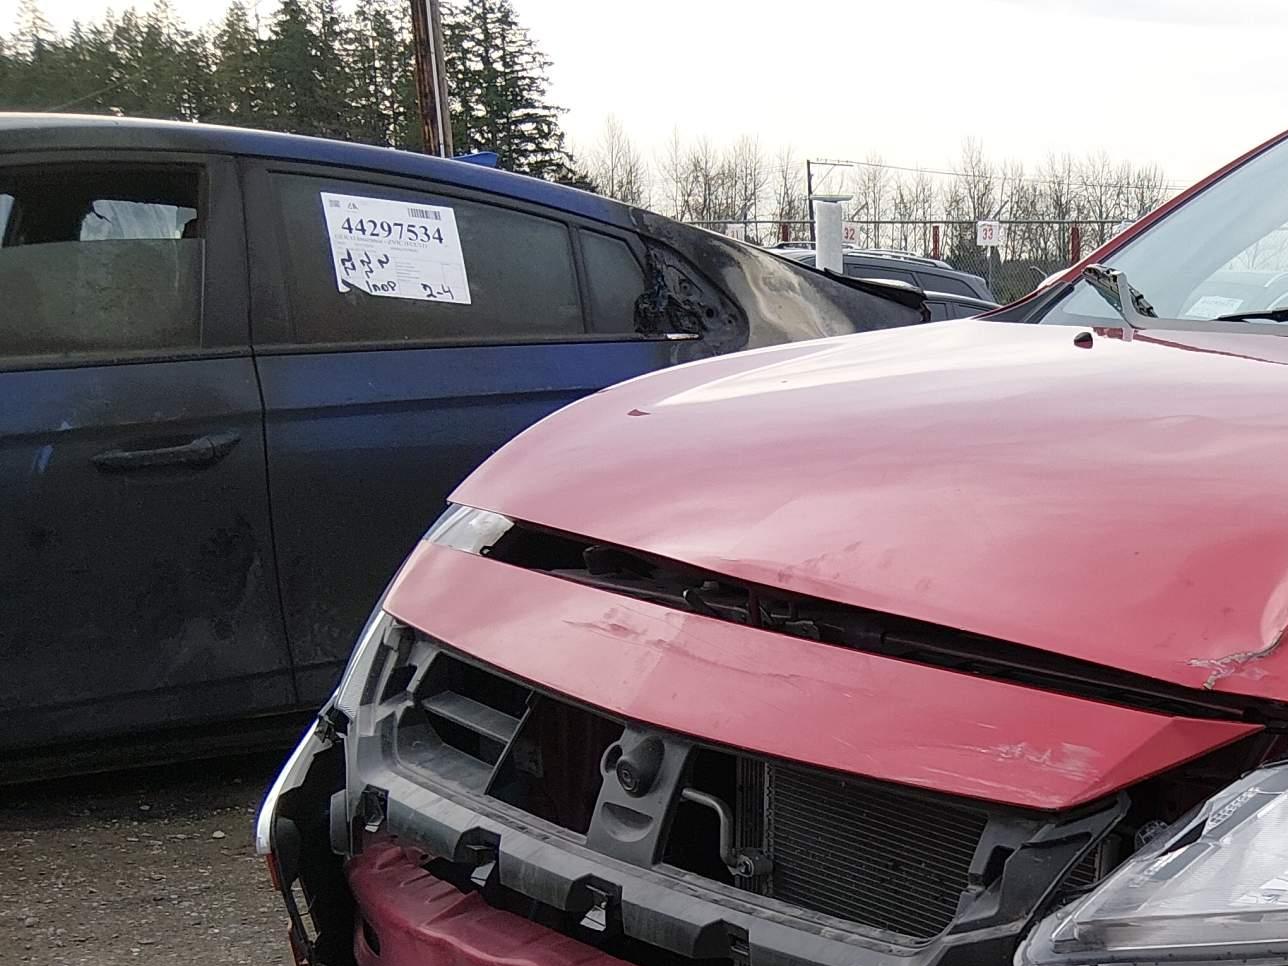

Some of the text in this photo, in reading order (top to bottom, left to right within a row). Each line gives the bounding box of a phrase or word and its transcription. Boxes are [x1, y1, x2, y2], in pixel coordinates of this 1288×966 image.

[341, 216, 443, 244] 44297534
[844, 227, 855, 240] 32
[982, 228, 994, 240] 33
